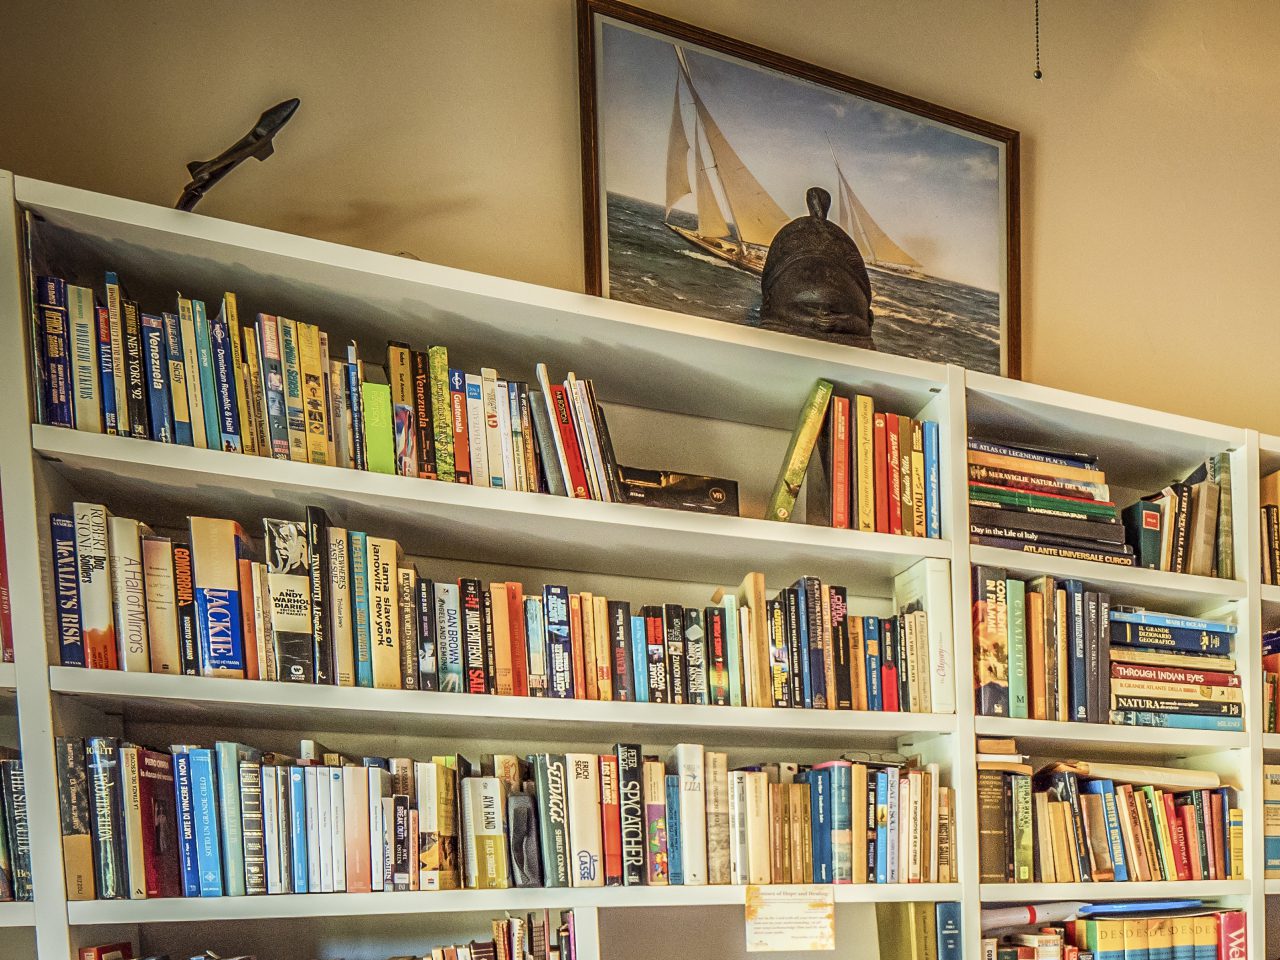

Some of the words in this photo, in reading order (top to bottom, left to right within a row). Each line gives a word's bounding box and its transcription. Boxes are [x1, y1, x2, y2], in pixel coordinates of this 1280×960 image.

[76, 322, 92, 362] WONDERFUL
[127, 336, 139, 356] NEW
[100, 343, 111, 373] MALTA
[149, 332, 163, 389] Venezuela
[217, 349, 228, 382] Dominican
[78, 365, 93, 400] WEEKENDS
[129, 360, 142, 385] YORK
[171, 362, 183, 384] Sicily
[220, 383, 230, 409] Republic
[333, 393, 343, 417] Africa
[415, 373, 429, 427] Venezuela
[225, 417, 234, 432] Haiti
[454, 394, 464, 433] Guatemala
[979, 443, 997, 453] ATLAS
[998, 447, 1007, 455] OF
[1008, 448, 1045, 462] LEGENDARY
[915, 492, 924, 527] NAPOLI
[77, 514, 95, 552] STONE
[91, 508, 107, 553] ROBERT
[970, 525, 984, 537] Day
[993, 529, 1003, 537] the
[1004, 530, 1015, 540] Life
[1016, 532, 1023, 540] of
[92, 556, 107, 570] Dog
[124, 557, 138, 569] A
[330, 543, 339, 561] EAST
[336, 539, 348, 589] SOMEWHERES
[1023, 544, 1058, 556] ATLANTE
[1058, 548, 1104, 562] UNIVERSALE
[1105, 555, 1132, 566] CURCIO
[56, 539, 78, 610] McNALLY'S
[80, 554, 94, 584] Soldiers
[174, 548, 193, 602] GOMORRAH
[371, 544, 385, 591] janowitz
[382, 563, 391, 592] tama
[125, 570, 142, 593] Hall
[986, 580, 995, 591] IN
[128, 595, 140, 607] of
[274, 603, 309, 611] DIARIES
[375, 596, 384, 619] new
[986, 593, 996, 633] FIAMME
[204, 588, 234, 657] JACKIE
[384, 597, 394, 634] slaves
[448, 608, 458, 630] DAN
[63, 613, 81, 646] RISK
[129, 609, 146, 655] Mirrors
[376, 620, 387, 646] york
[386, 636, 395, 648] of
[1014, 600, 1024, 677] CANALETTO
[1138, 637, 1176, 646] GEOGRAFICO
[448, 630, 460, 664] BROWN
[648, 662, 659, 689] STUART
[657, 662, 666, 690] WOODS
[673, 679, 683, 694] DEAN
[1117, 666, 1156, 679] THROUGH
[1158, 670, 1185, 681] INDIAN
[1187, 674, 1204, 683] EYES
[1118, 698, 1160, 710] NATURA
[575, 760, 583, 780] SEGAL
[582, 761, 590, 780] ERICH
[483, 795, 495, 809] AYN
[547, 761, 565, 824] SELVAGGE
[1127, 791, 1136, 807] NEW
[484, 811, 496, 830] RAND
[621, 781, 644, 865] SPYCATCHER
[1130, 807, 1139, 827] YORK
[1109, 829, 1123, 866] DICTIONARY
[1100, 930, 1124, 940] DES
